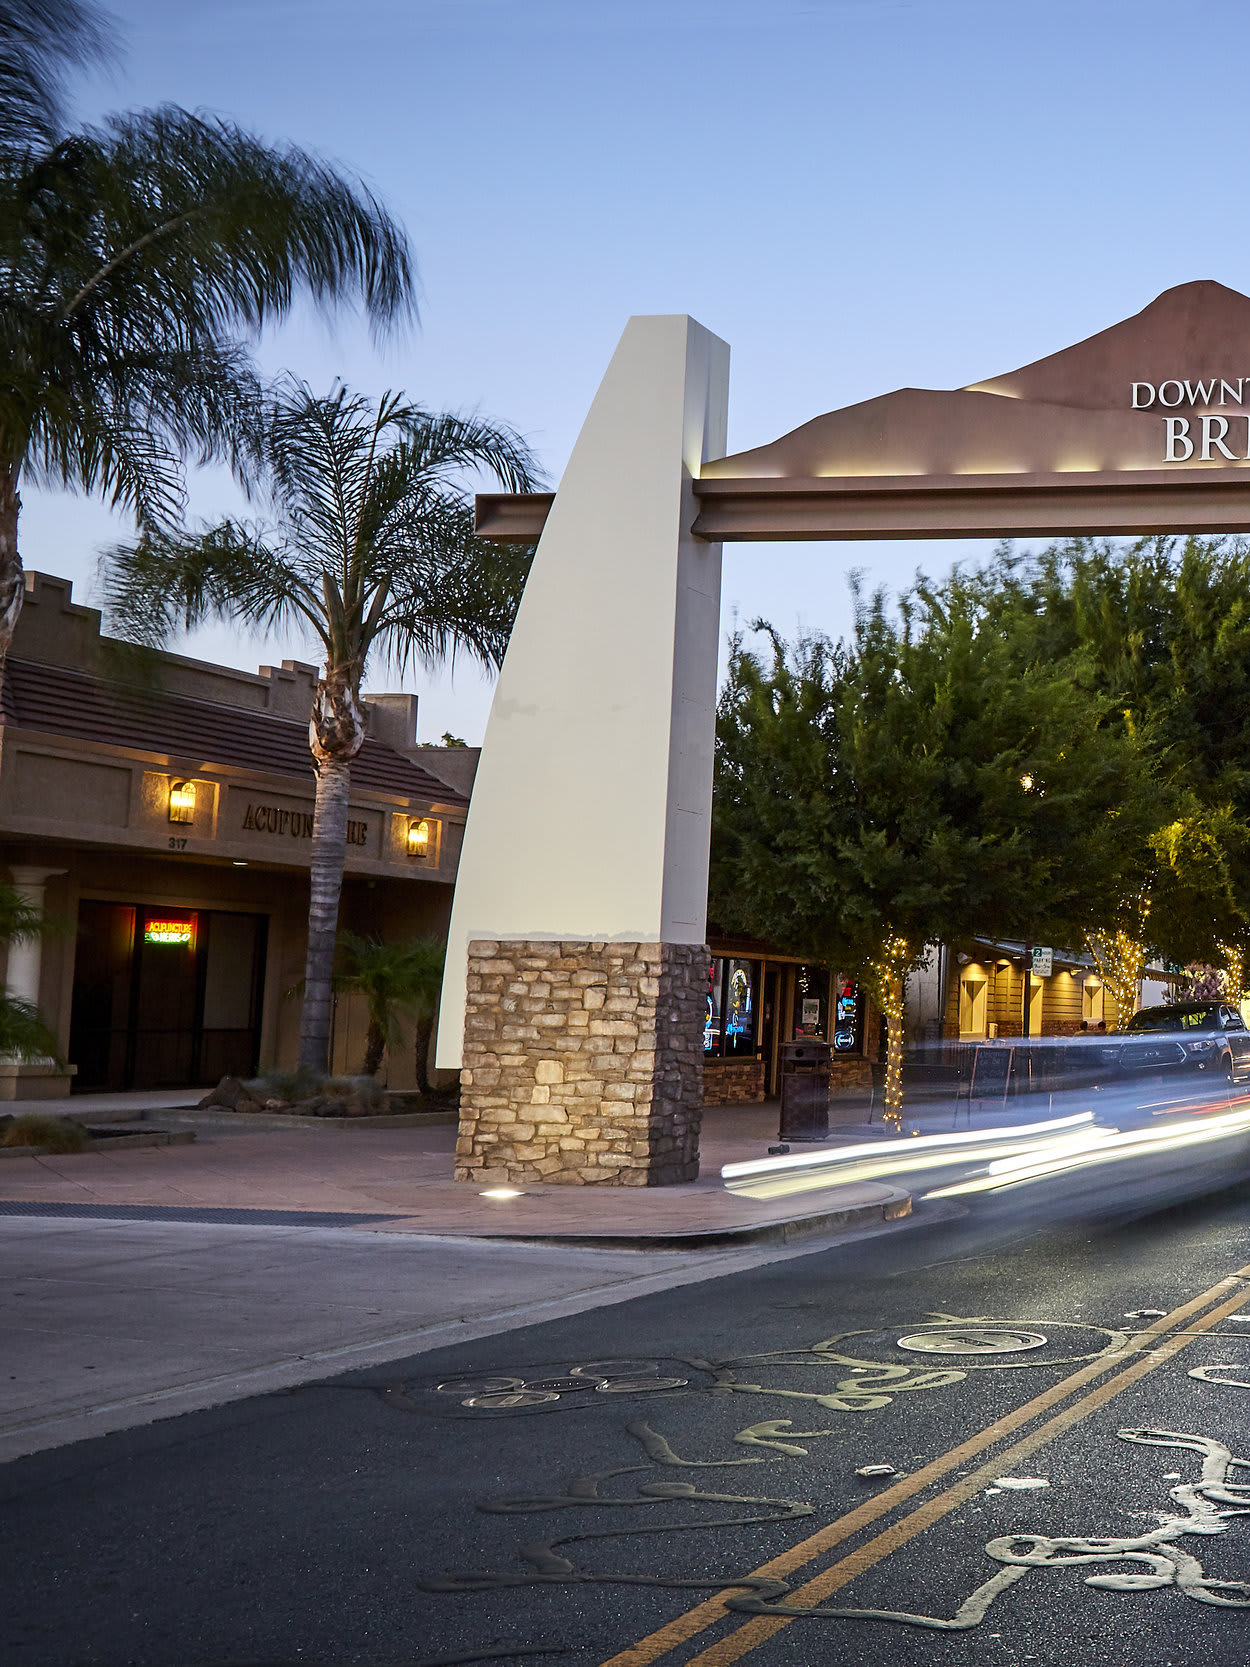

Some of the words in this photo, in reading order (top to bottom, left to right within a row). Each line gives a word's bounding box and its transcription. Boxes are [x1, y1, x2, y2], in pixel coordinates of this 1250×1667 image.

[243, 804, 368, 847] ACUPUNRE
[168, 837, 188, 850] 317
[149, 922, 192, 934] ACUPUNCTURE
